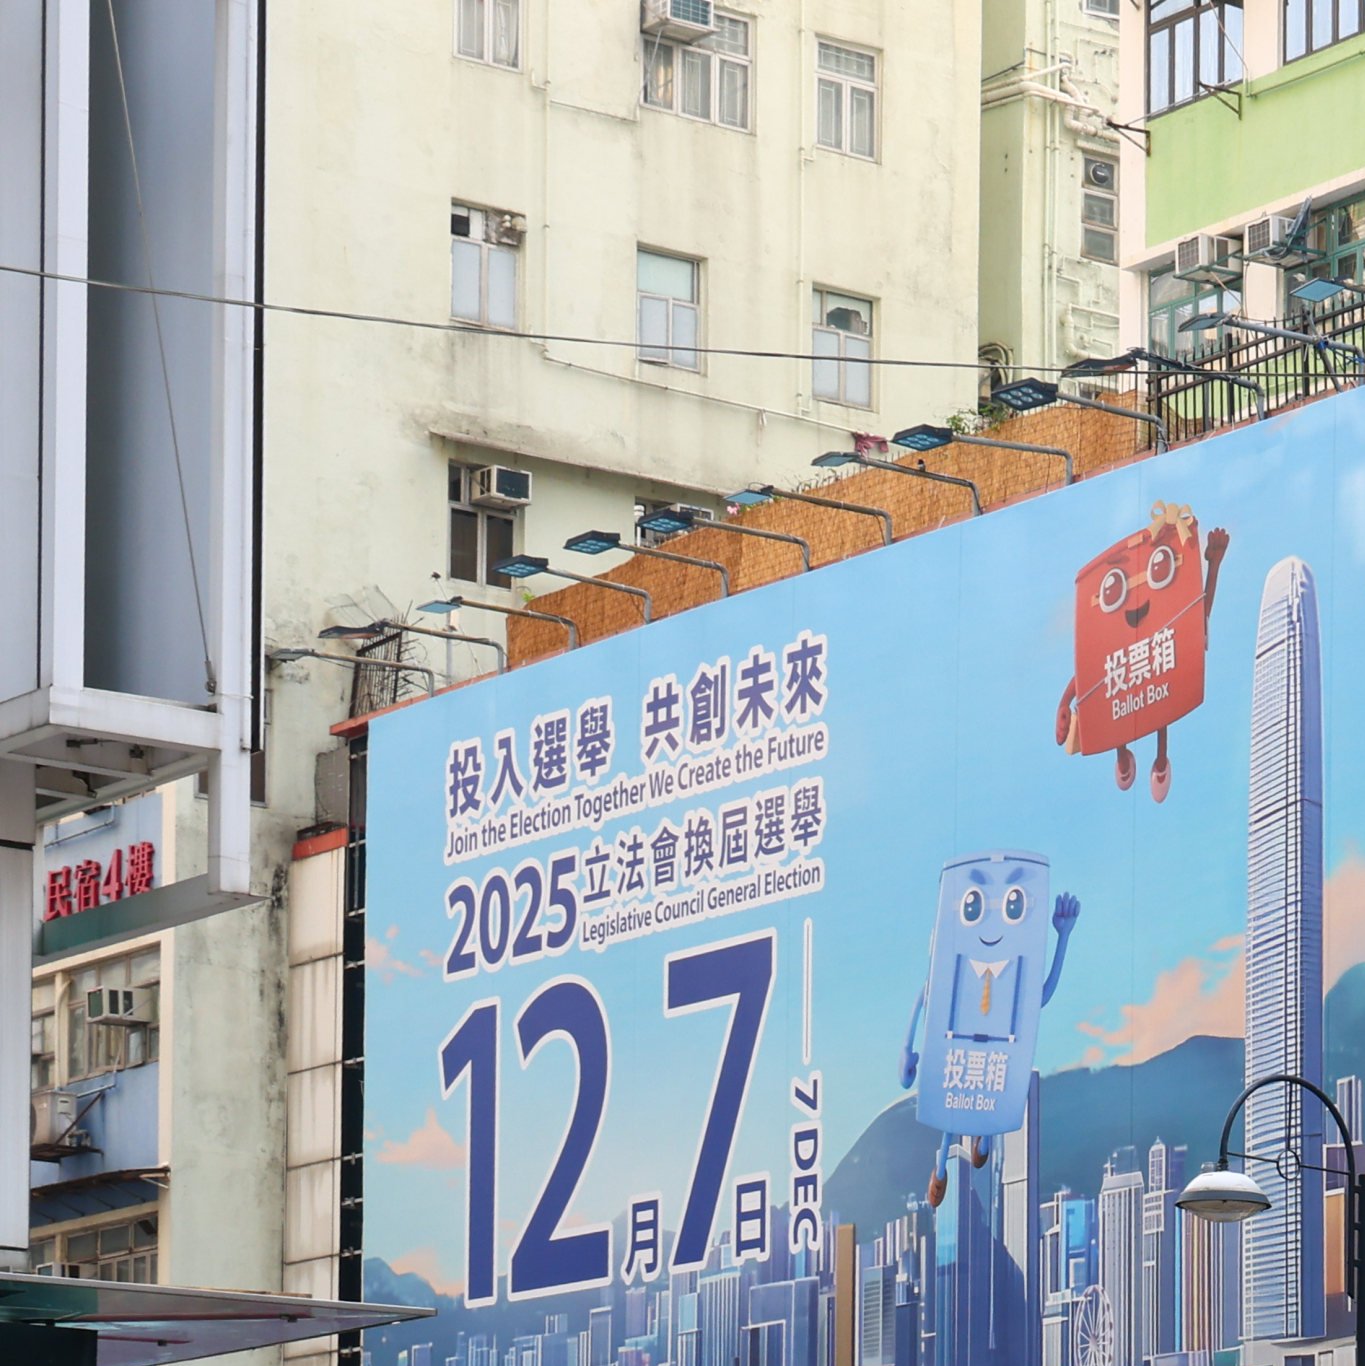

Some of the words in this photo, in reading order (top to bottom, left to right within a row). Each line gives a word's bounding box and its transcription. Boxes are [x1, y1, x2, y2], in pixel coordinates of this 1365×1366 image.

[1104, 627, 1177, 699] 投票箱
[1111, 697, 1146, 721] Ballot
[1147, 682, 1170, 704] Box
[448, 702, 612, 820] 投入選舉
[644, 638, 825, 759] 共創未來
[447, 830, 478, 858] Join
[482, 823, 507, 849] the
[510, 802, 572, 840] Election
[574, 783, 646, 823] Together
[649, 770, 675, 800] We
[678, 757, 733, 792] Create
[735, 745, 764, 774] the
[767, 728, 825, 764] Future
[44, 841, 155, 922] 民宿4樓
[583, 785, 823, 905] 立法會換屆選舉
[447, 855, 578, 976] 2025
[582, 911, 653, 945] Legislative
[654, 893, 705, 924] Council
[707, 876, 762, 912] General
[765, 865, 822, 896] Election
[943, 1048, 1009, 1093] 投票箱
[945, 1092, 976, 1110] Ballot
[977, 1094, 997, 1112] Box
